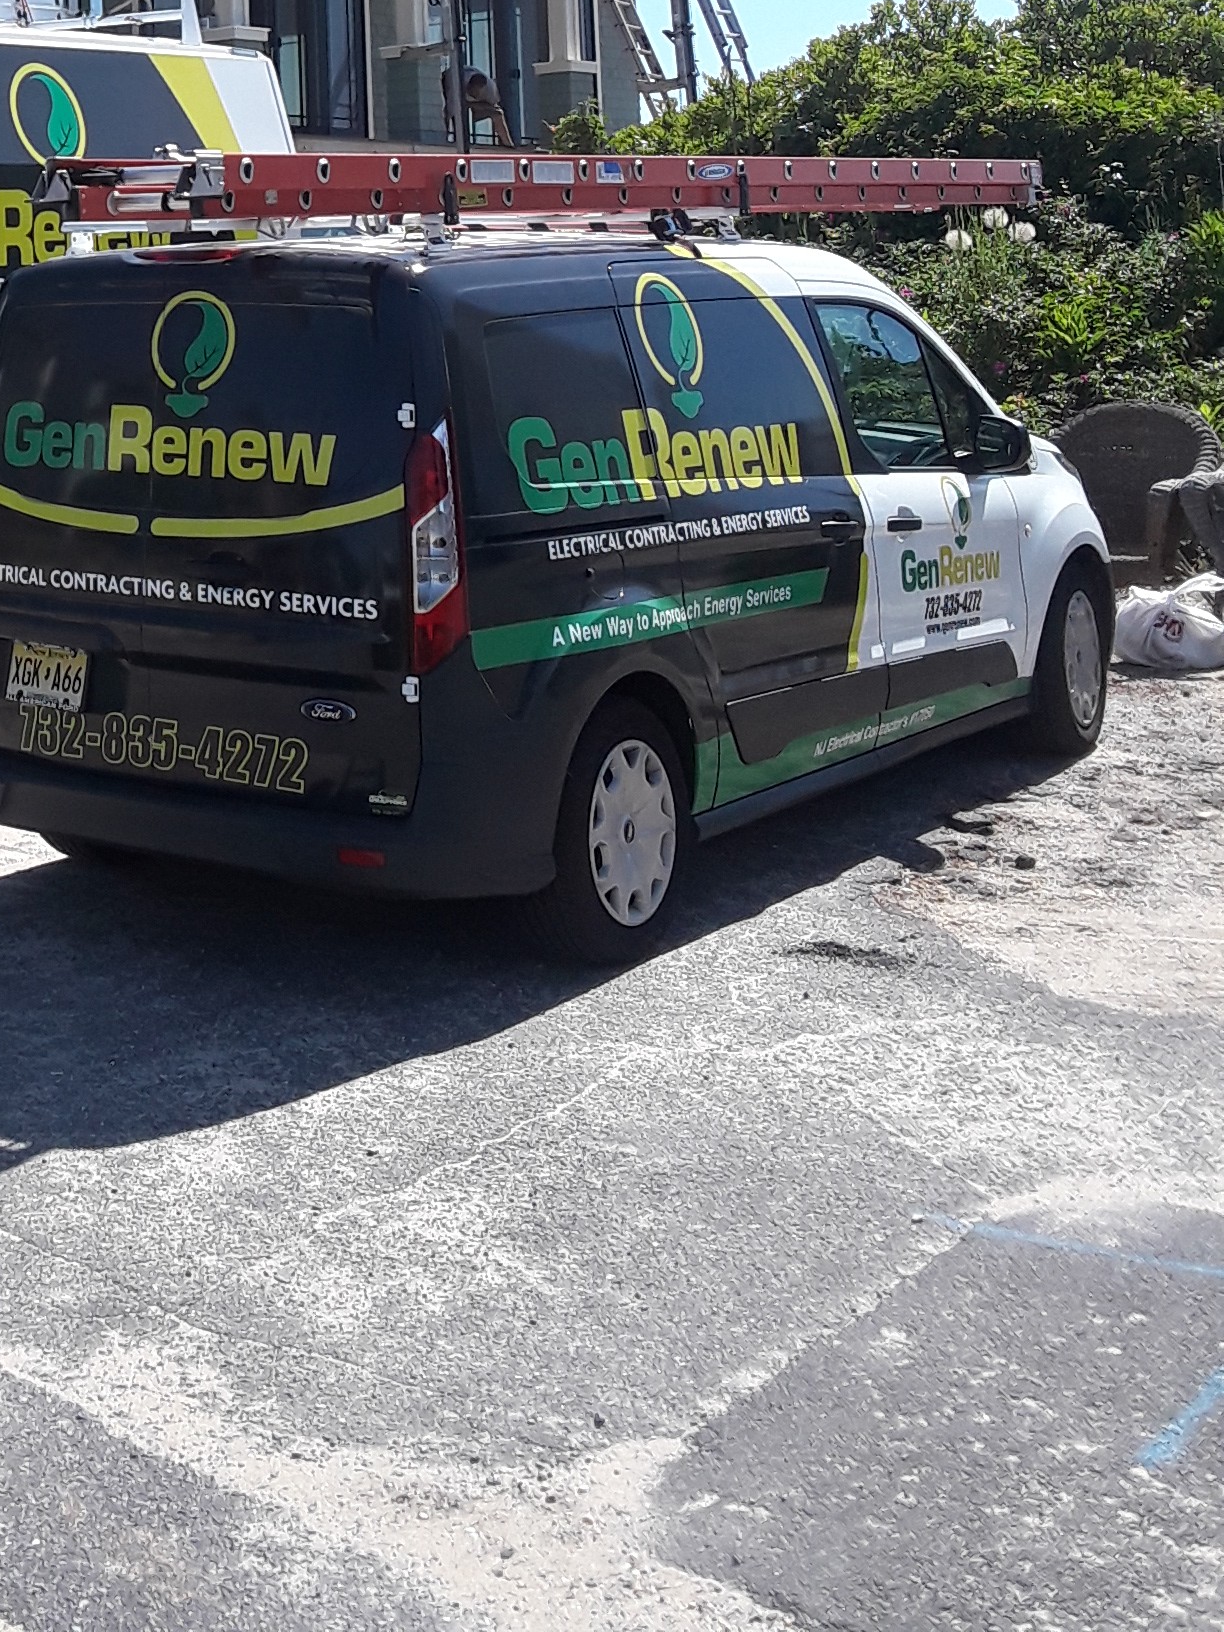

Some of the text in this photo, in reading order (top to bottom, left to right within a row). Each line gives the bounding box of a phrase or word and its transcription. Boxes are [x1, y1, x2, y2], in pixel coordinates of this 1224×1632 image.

[3, 400, 338, 486] GenRenew
[508, 408, 802, 514] GenRenew
[547, 505, 811, 561] ELECTRICAL CONTRACTING & ENERGY SERVICES
[49, 569, 175, 600] CONTRACTING
[179, 581, 192, 602] &
[197, 583, 275, 610] ENERGY
[279, 591, 378, 620] SERVICES
[901, 545, 1001, 593] GenRenew
[552, 585, 792, 647] A New Way to Approach Energy Services
[924, 588, 983, 620] 732-835-4272
[50, 662, 83, 695] A66
[311, 703, 342, 720] Ford
[19, 703, 308, 794] 732-835-4272
